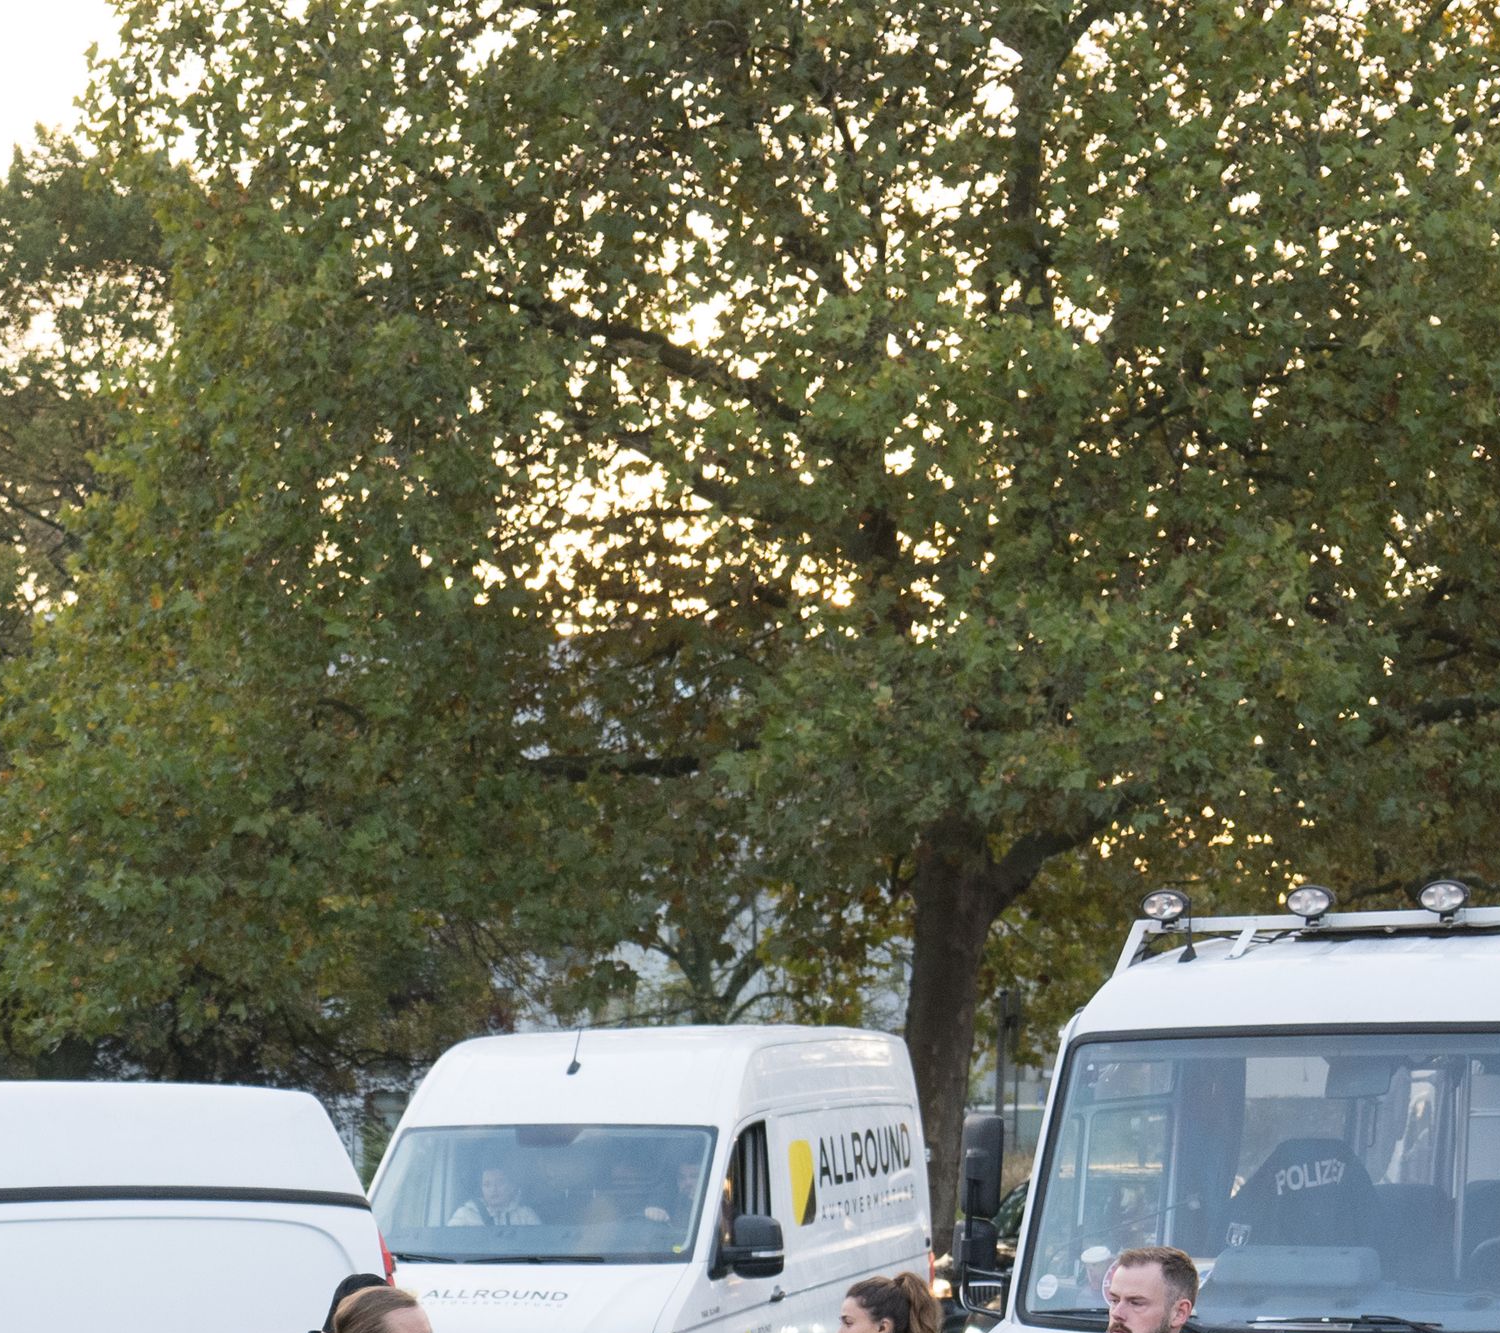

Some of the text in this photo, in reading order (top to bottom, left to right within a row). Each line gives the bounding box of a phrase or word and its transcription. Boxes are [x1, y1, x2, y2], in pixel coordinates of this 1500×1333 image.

[819, 1122, 911, 1189] ALLROUND
[1275, 1158, 1346, 1195] POLIZEI
[421, 1289, 569, 1302] ALLROUND
